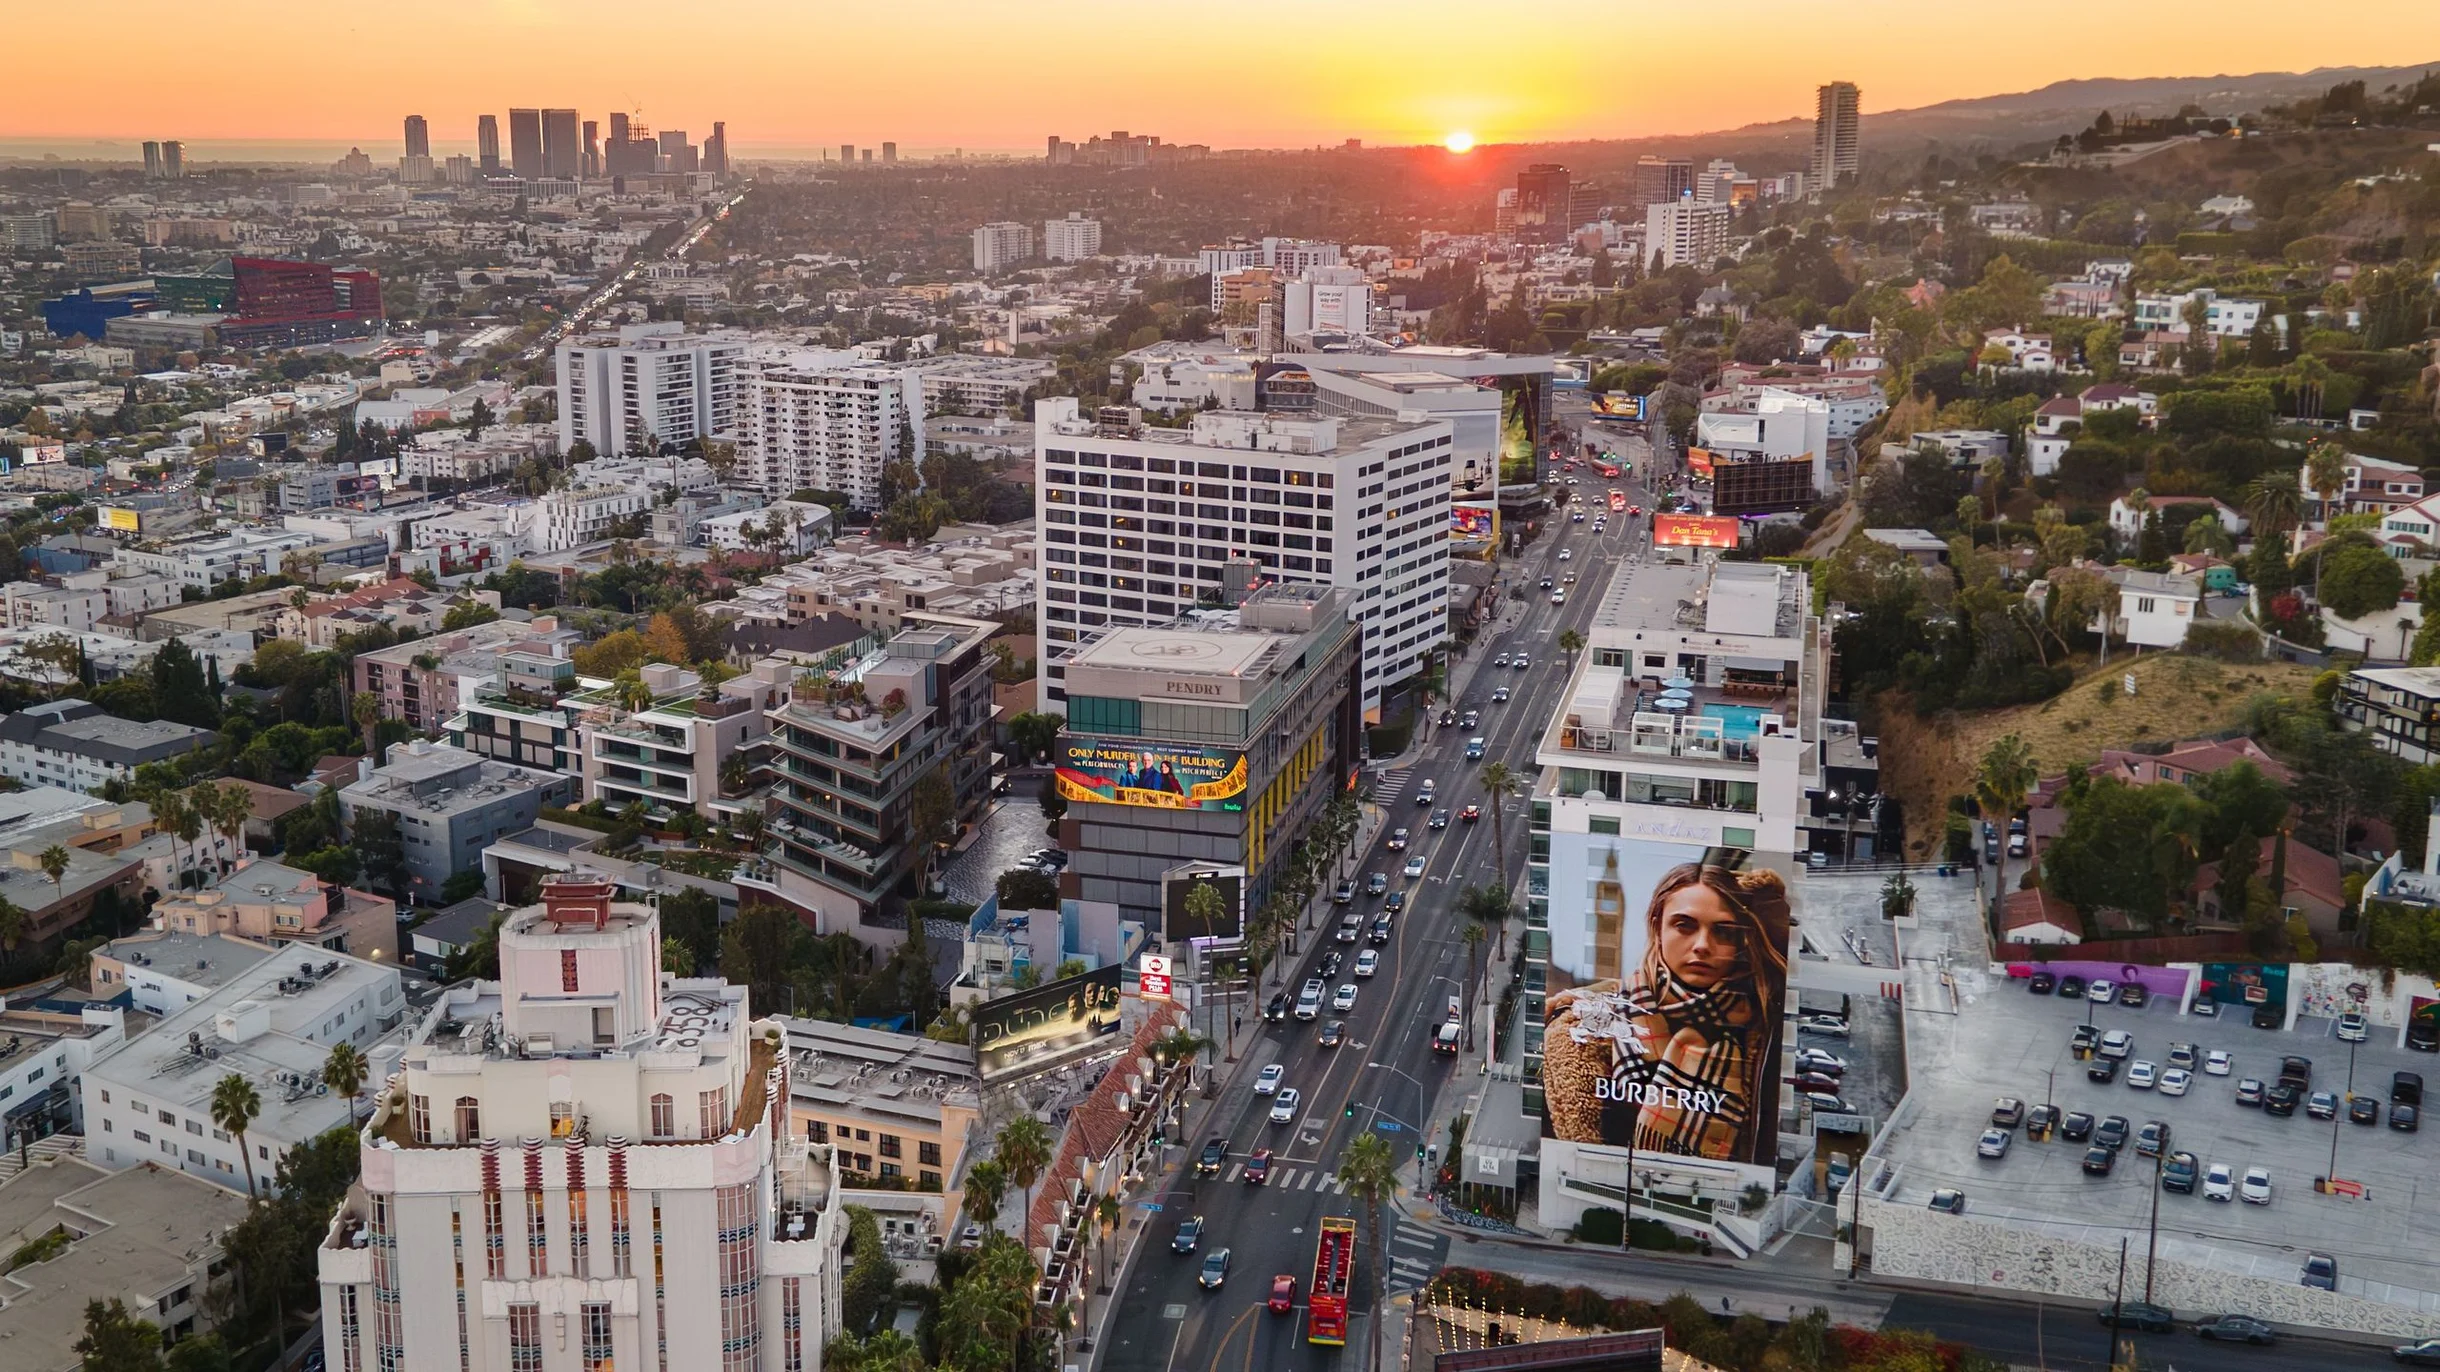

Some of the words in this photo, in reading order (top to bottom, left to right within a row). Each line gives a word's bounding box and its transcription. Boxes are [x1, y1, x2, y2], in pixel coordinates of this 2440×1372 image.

[1671, 525, 1690, 535] Dan
[1692, 526, 1718, 536] Tana's
[1166, 681, 1222, 695] PENDRY
[1068, 747, 1094, 759] ONLY
[1096, 750, 1140, 762] MURDERS
[1165, 755, 1178, 763] THE
[1181, 756, 1225, 768] BUILDING
[1224, 803, 1242, 811] hulu
[656, 1007, 714, 1047] 8358
[984, 1001, 1066, 1043] DUNE
[1003, 1049, 1019, 1060] NOV
[1595, 1077, 1727, 1114] BURBERRY
